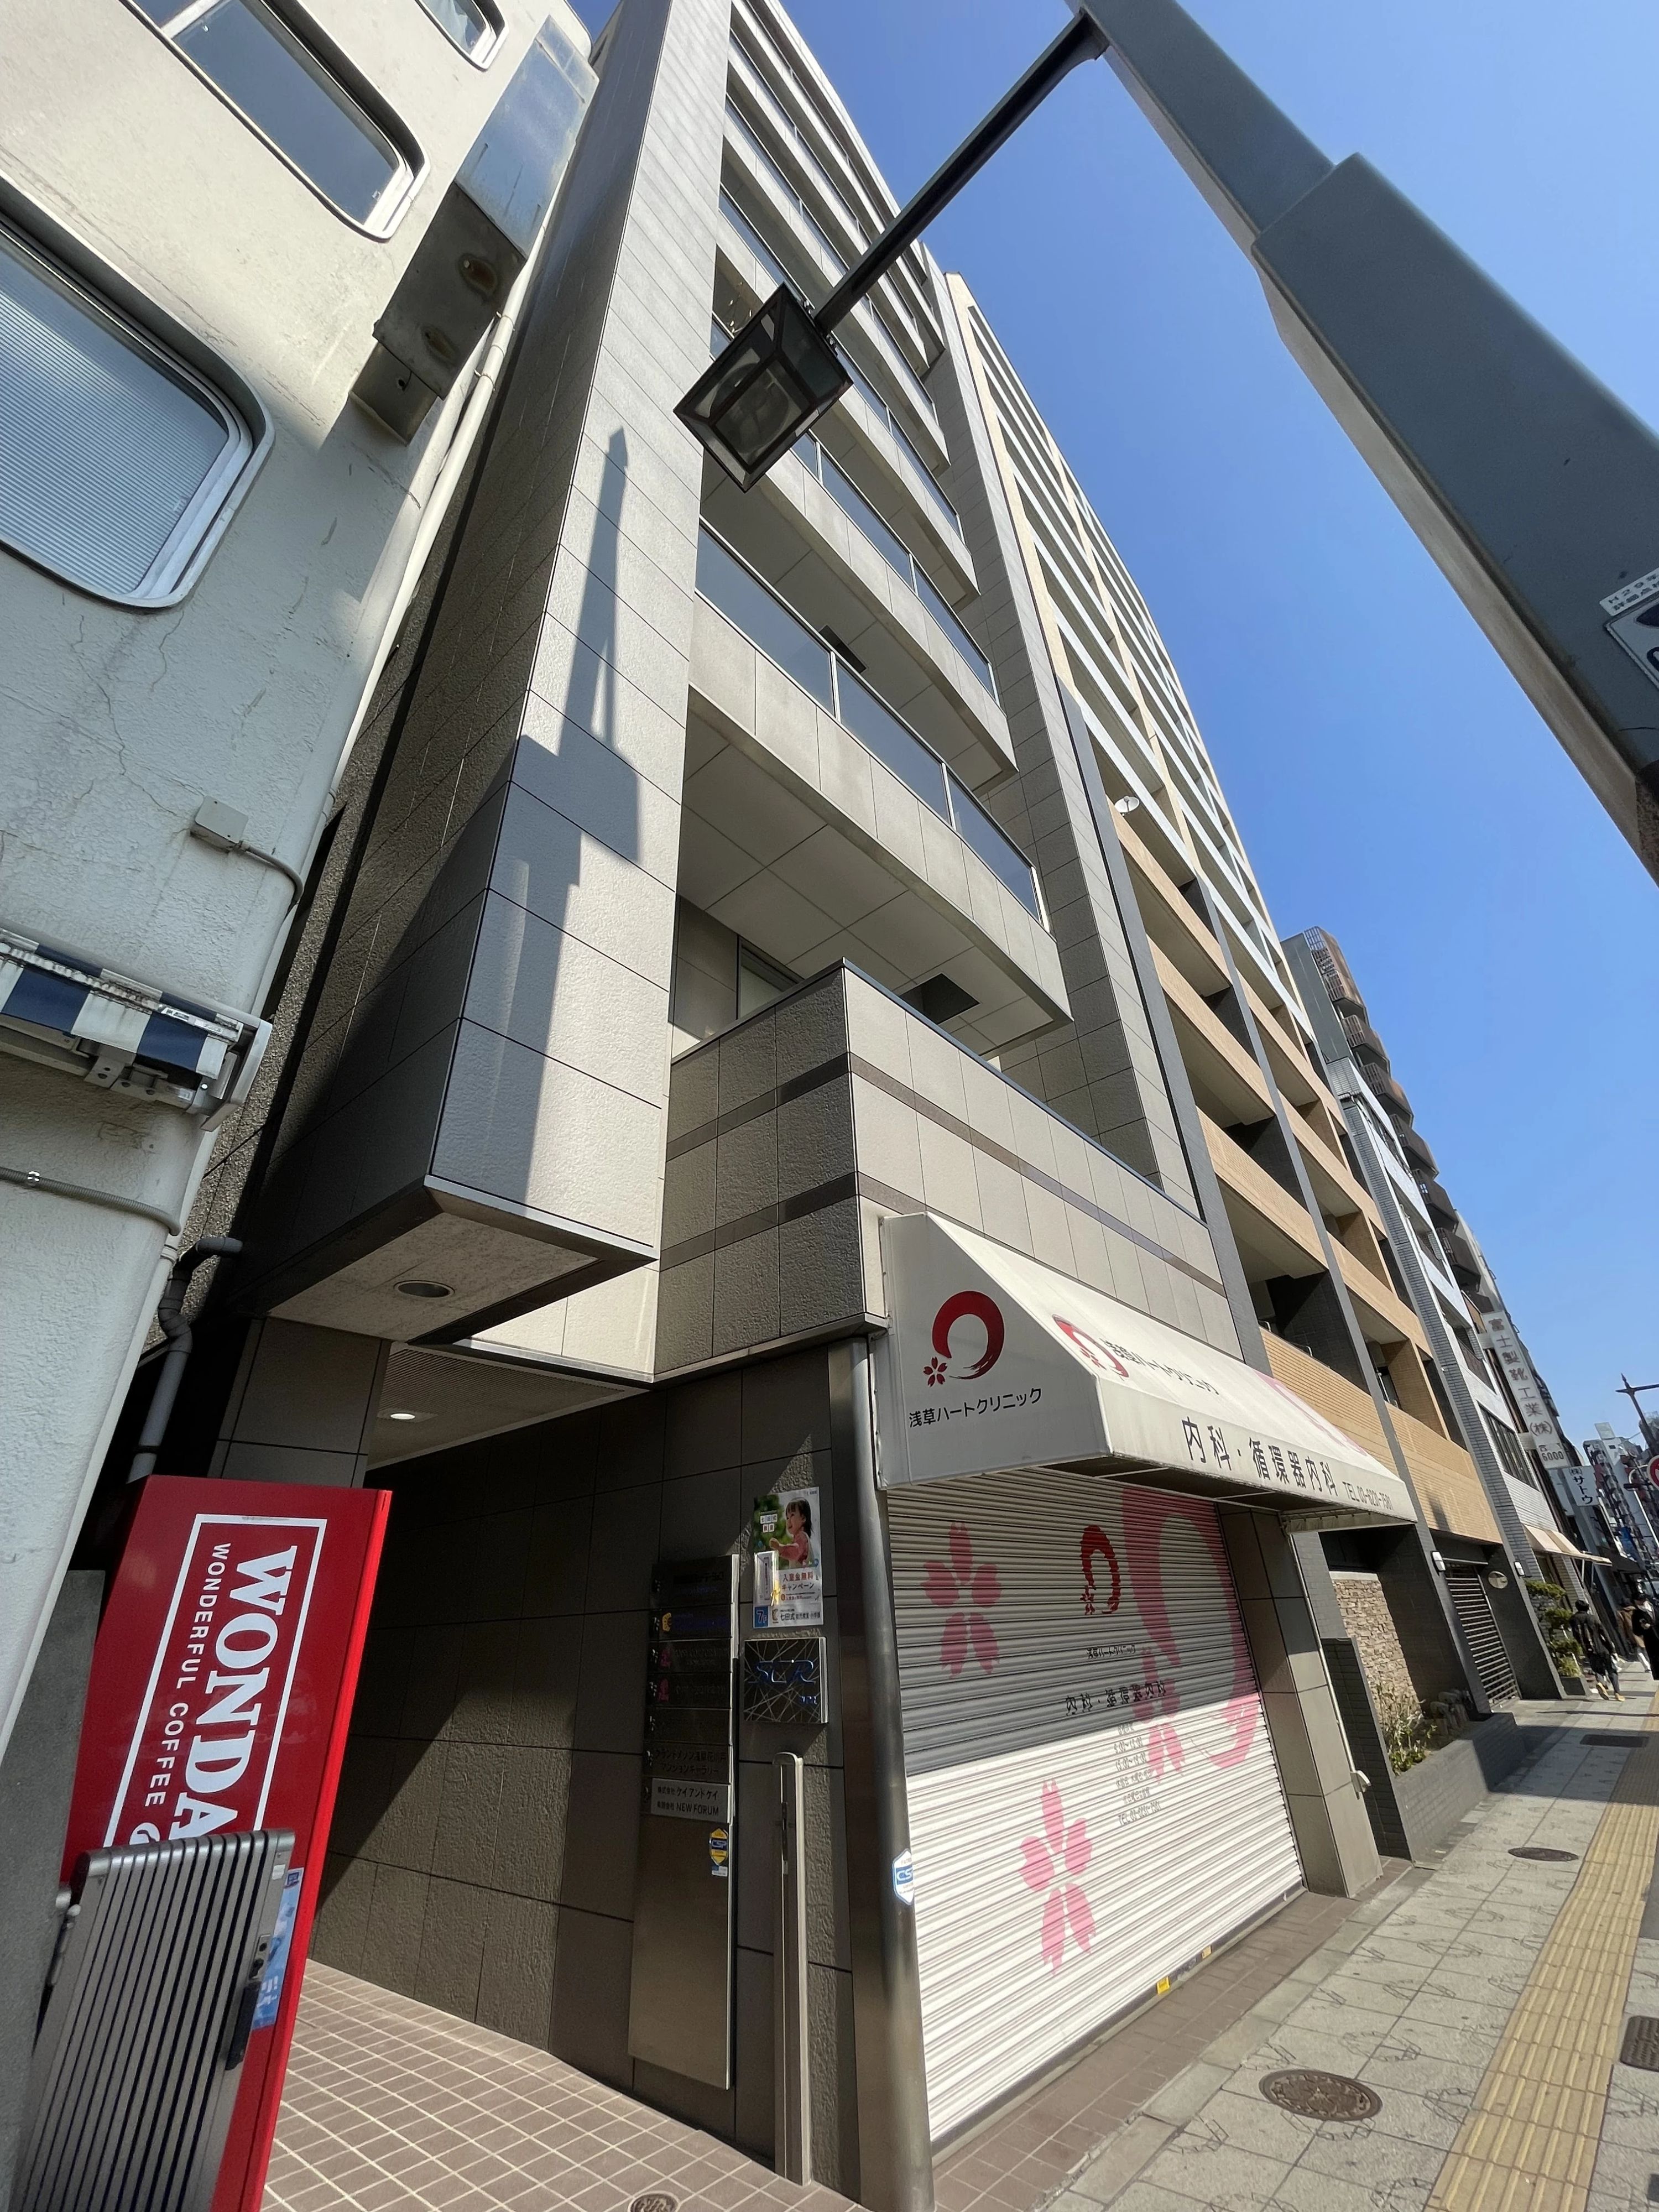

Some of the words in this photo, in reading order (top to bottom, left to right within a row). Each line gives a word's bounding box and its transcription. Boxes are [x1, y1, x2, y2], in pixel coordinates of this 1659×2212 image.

[909, 1387, 1042, 1428] 浅草ハートクリニック
[1182, 1416, 1339, 1496] 内科・循環器内科
[1542, 1451, 1564, 1461] 6000
[1342, 1481, 1360, 1502] TEL
[781, 1582, 814, 1591] キャンペーン
[176, 1542, 231, 1689] WONDERFUL
[169, 1544, 298, 1840] WONDA
[145, 1703, 189, 1807] COFFEE
[676, 1787, 718, 1801] ケイアンドケイ
[676, 1802, 692, 1812] NEW
[693, 1804, 719, 1815] FORUM
